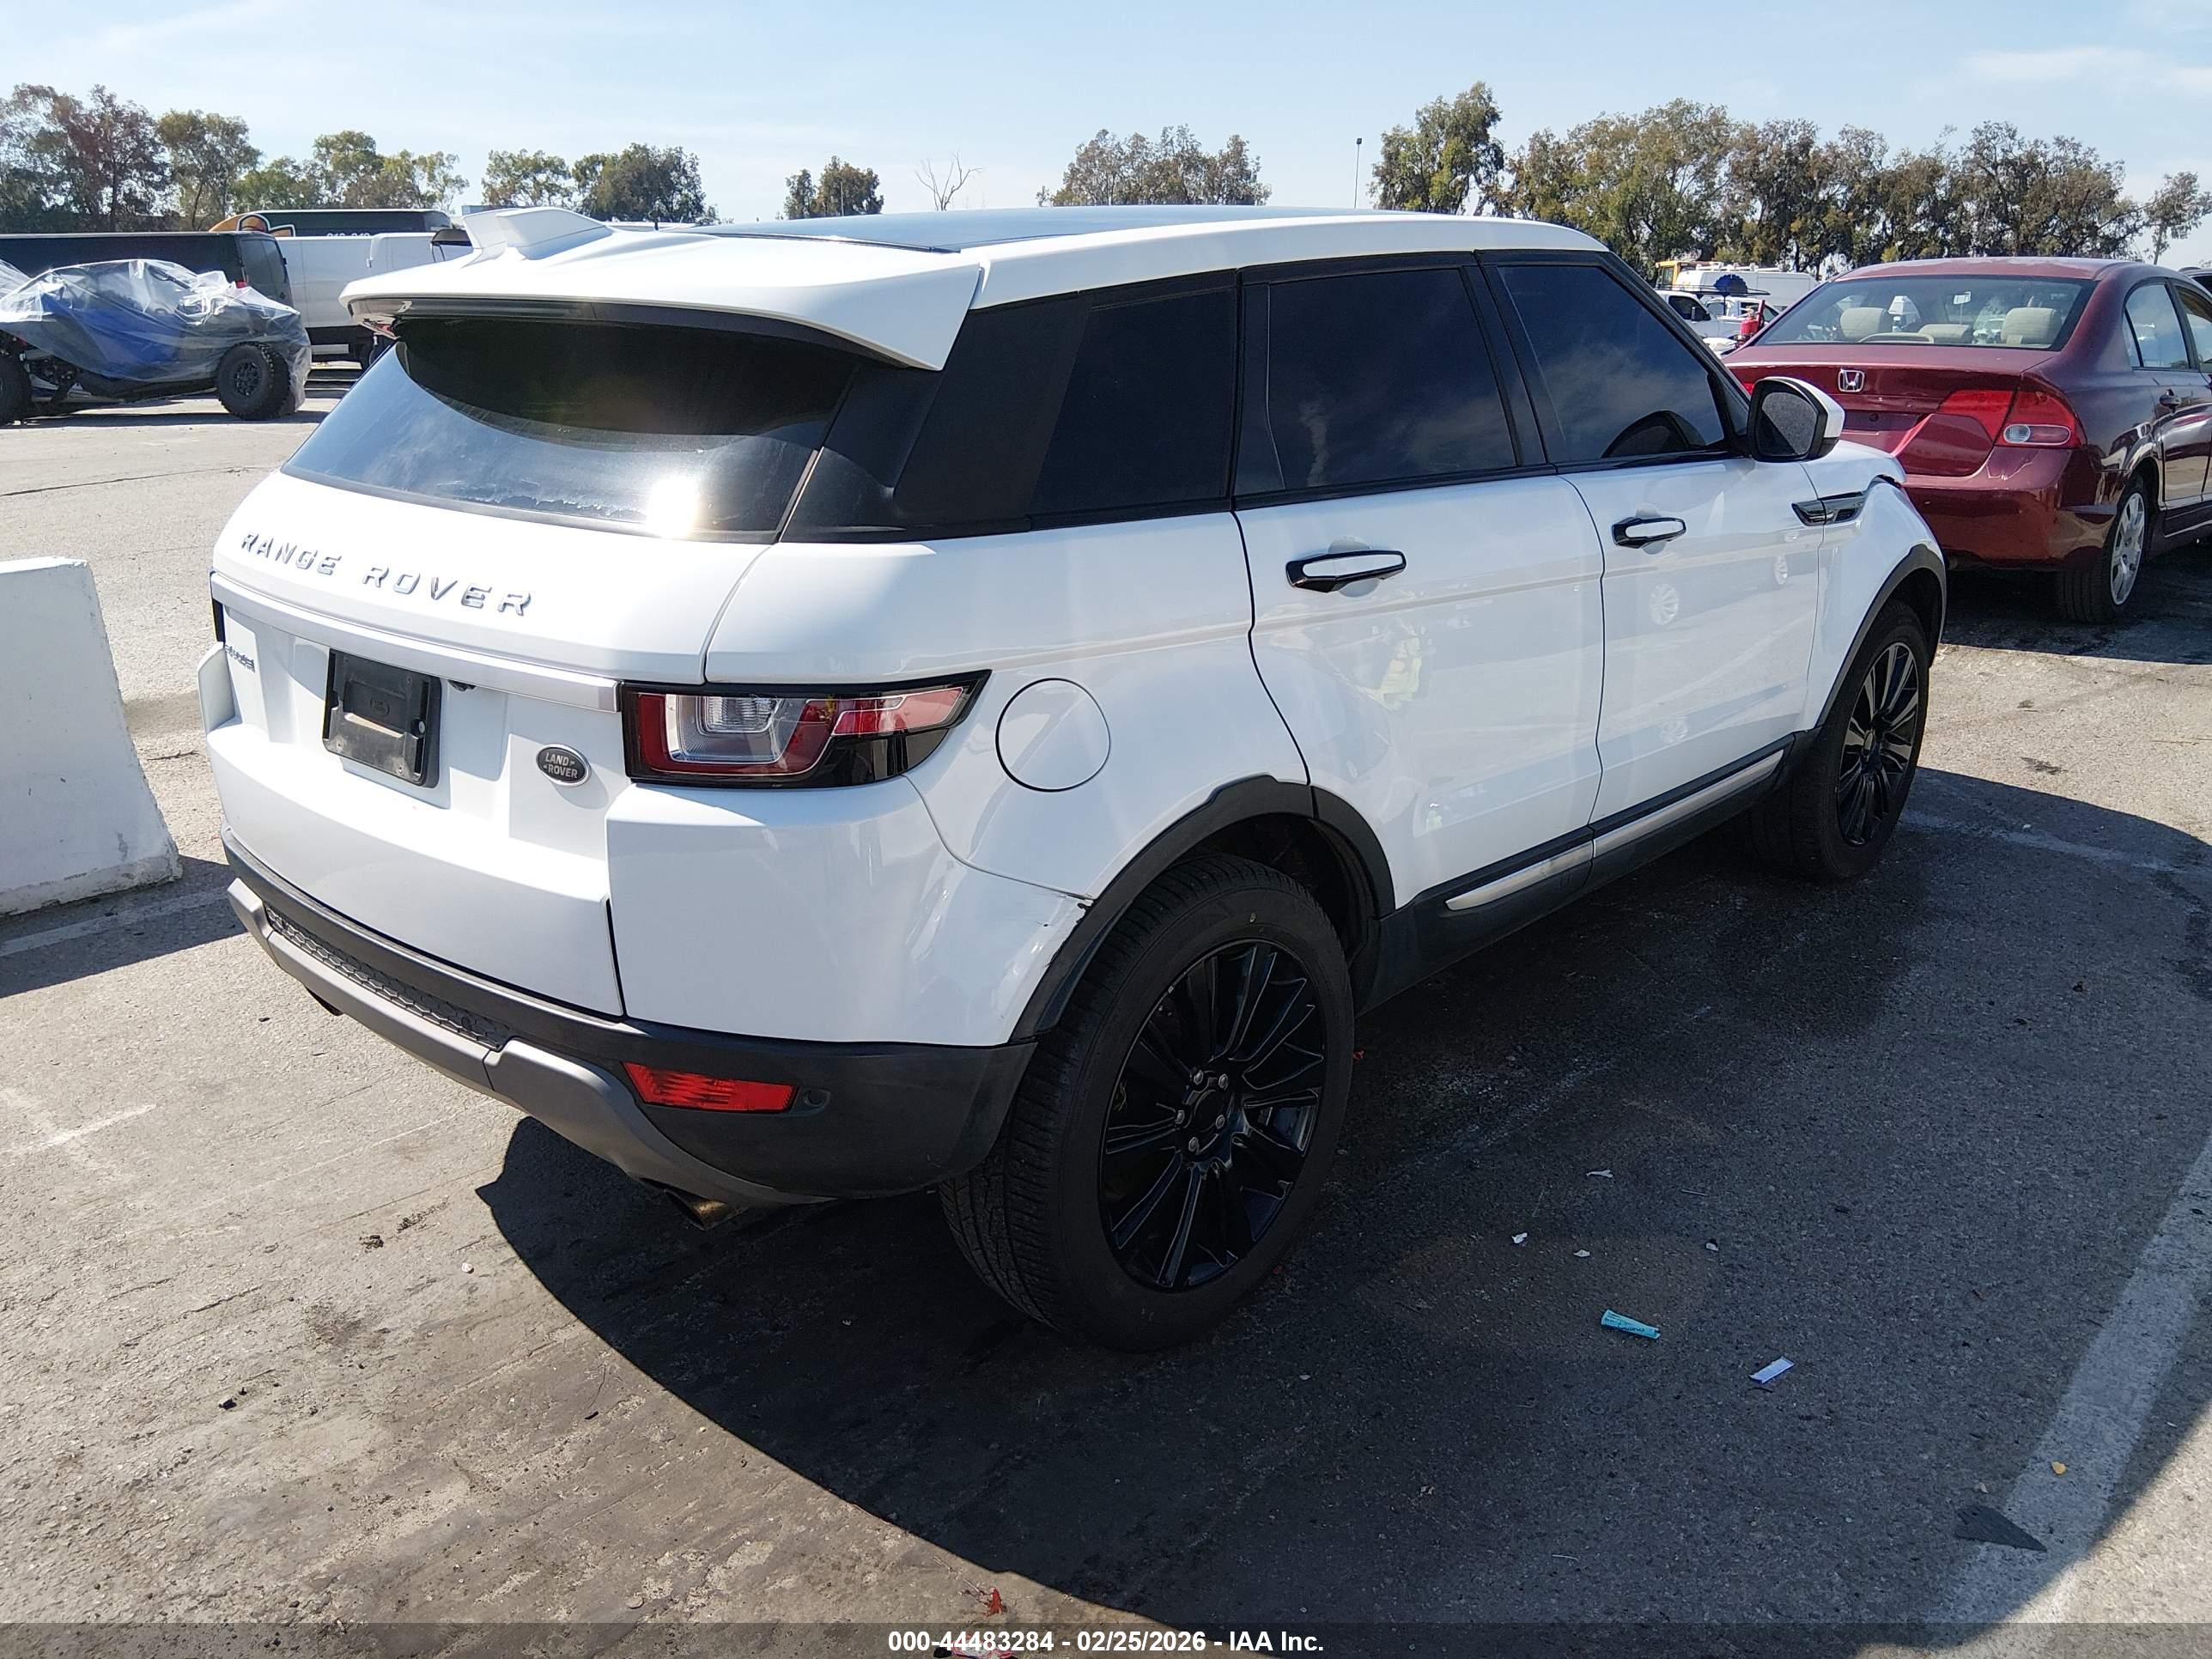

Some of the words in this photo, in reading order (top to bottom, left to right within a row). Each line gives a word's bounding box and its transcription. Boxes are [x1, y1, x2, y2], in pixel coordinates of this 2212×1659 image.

[240, 532, 343, 576] RANGE
[362, 567, 532, 617] ROVER
[544, 752, 569, 767] LAND
[548, 763, 579, 779] ROVER
